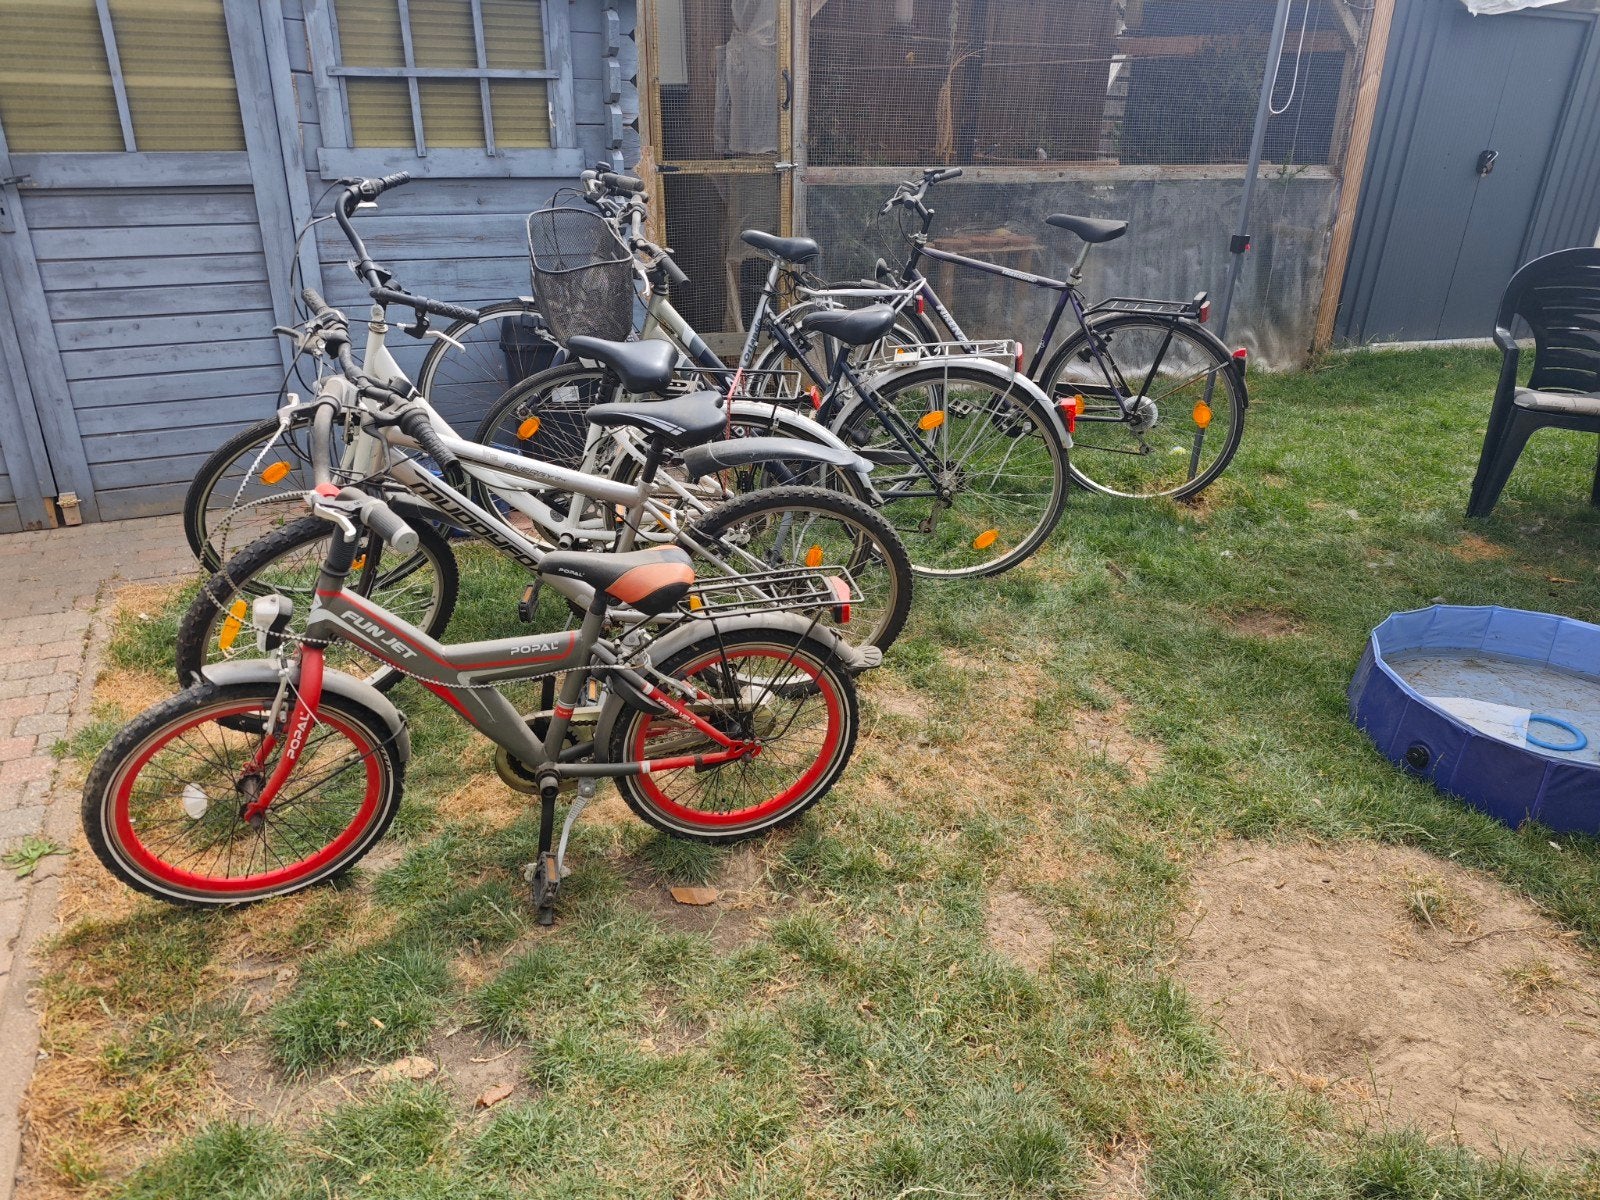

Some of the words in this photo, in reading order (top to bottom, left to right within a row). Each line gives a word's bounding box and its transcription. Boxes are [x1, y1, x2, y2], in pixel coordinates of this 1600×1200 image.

[558, 567, 584, 577] POPAL
[340, 610, 386, 638] FUN
[380, 637, 418, 659] JET
[510, 641, 559, 656] POPAL
[286, 711, 311, 760] POPAL
